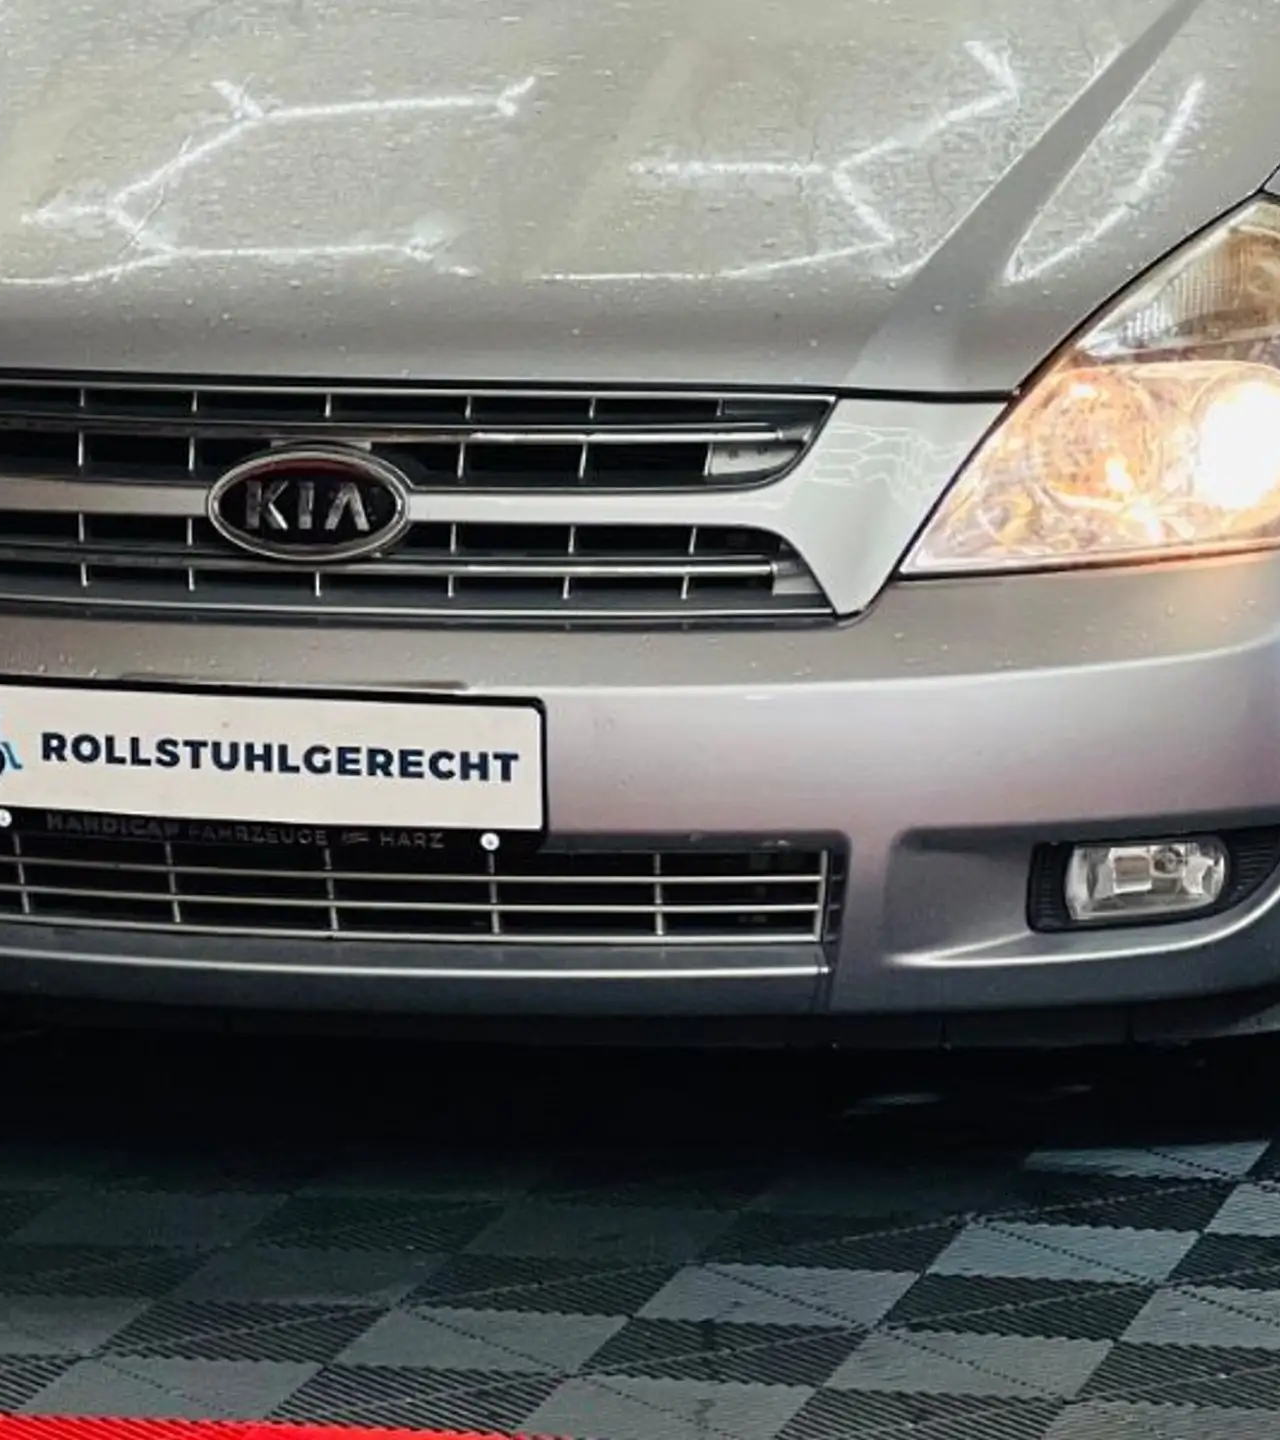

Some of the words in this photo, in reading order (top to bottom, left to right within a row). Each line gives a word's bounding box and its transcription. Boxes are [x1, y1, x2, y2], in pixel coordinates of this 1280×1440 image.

[245, 481, 370, 530] KIA
[41, 731, 520, 783] ROLLSTUHLGERECHT
[46, 811, 180, 838] HANDICAP
[188, 823, 329, 847] FAHRZEUGE
[380, 830, 446, 849] HARZ
